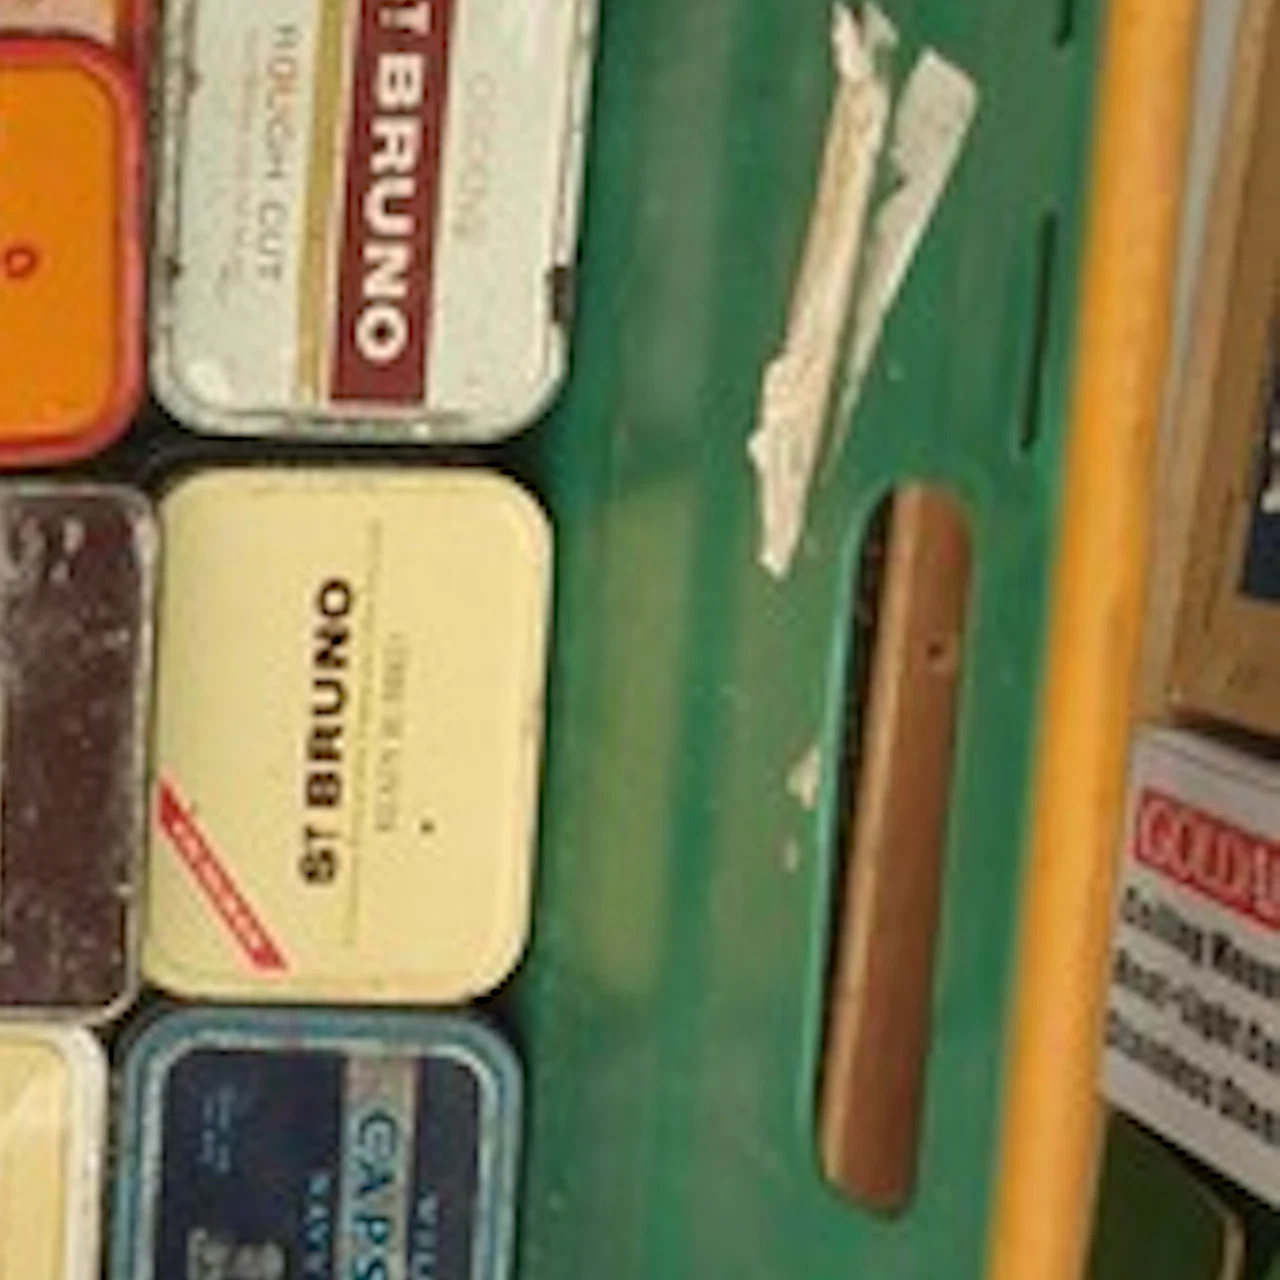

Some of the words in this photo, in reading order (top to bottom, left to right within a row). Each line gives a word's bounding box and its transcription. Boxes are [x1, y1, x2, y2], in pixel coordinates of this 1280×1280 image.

[266, 24, 300, 180] ROUGH
[256, 198, 288, 282] CUT
[356, 53, 425, 362] BRUNO
[302, 576, 353, 808] BRUNO
